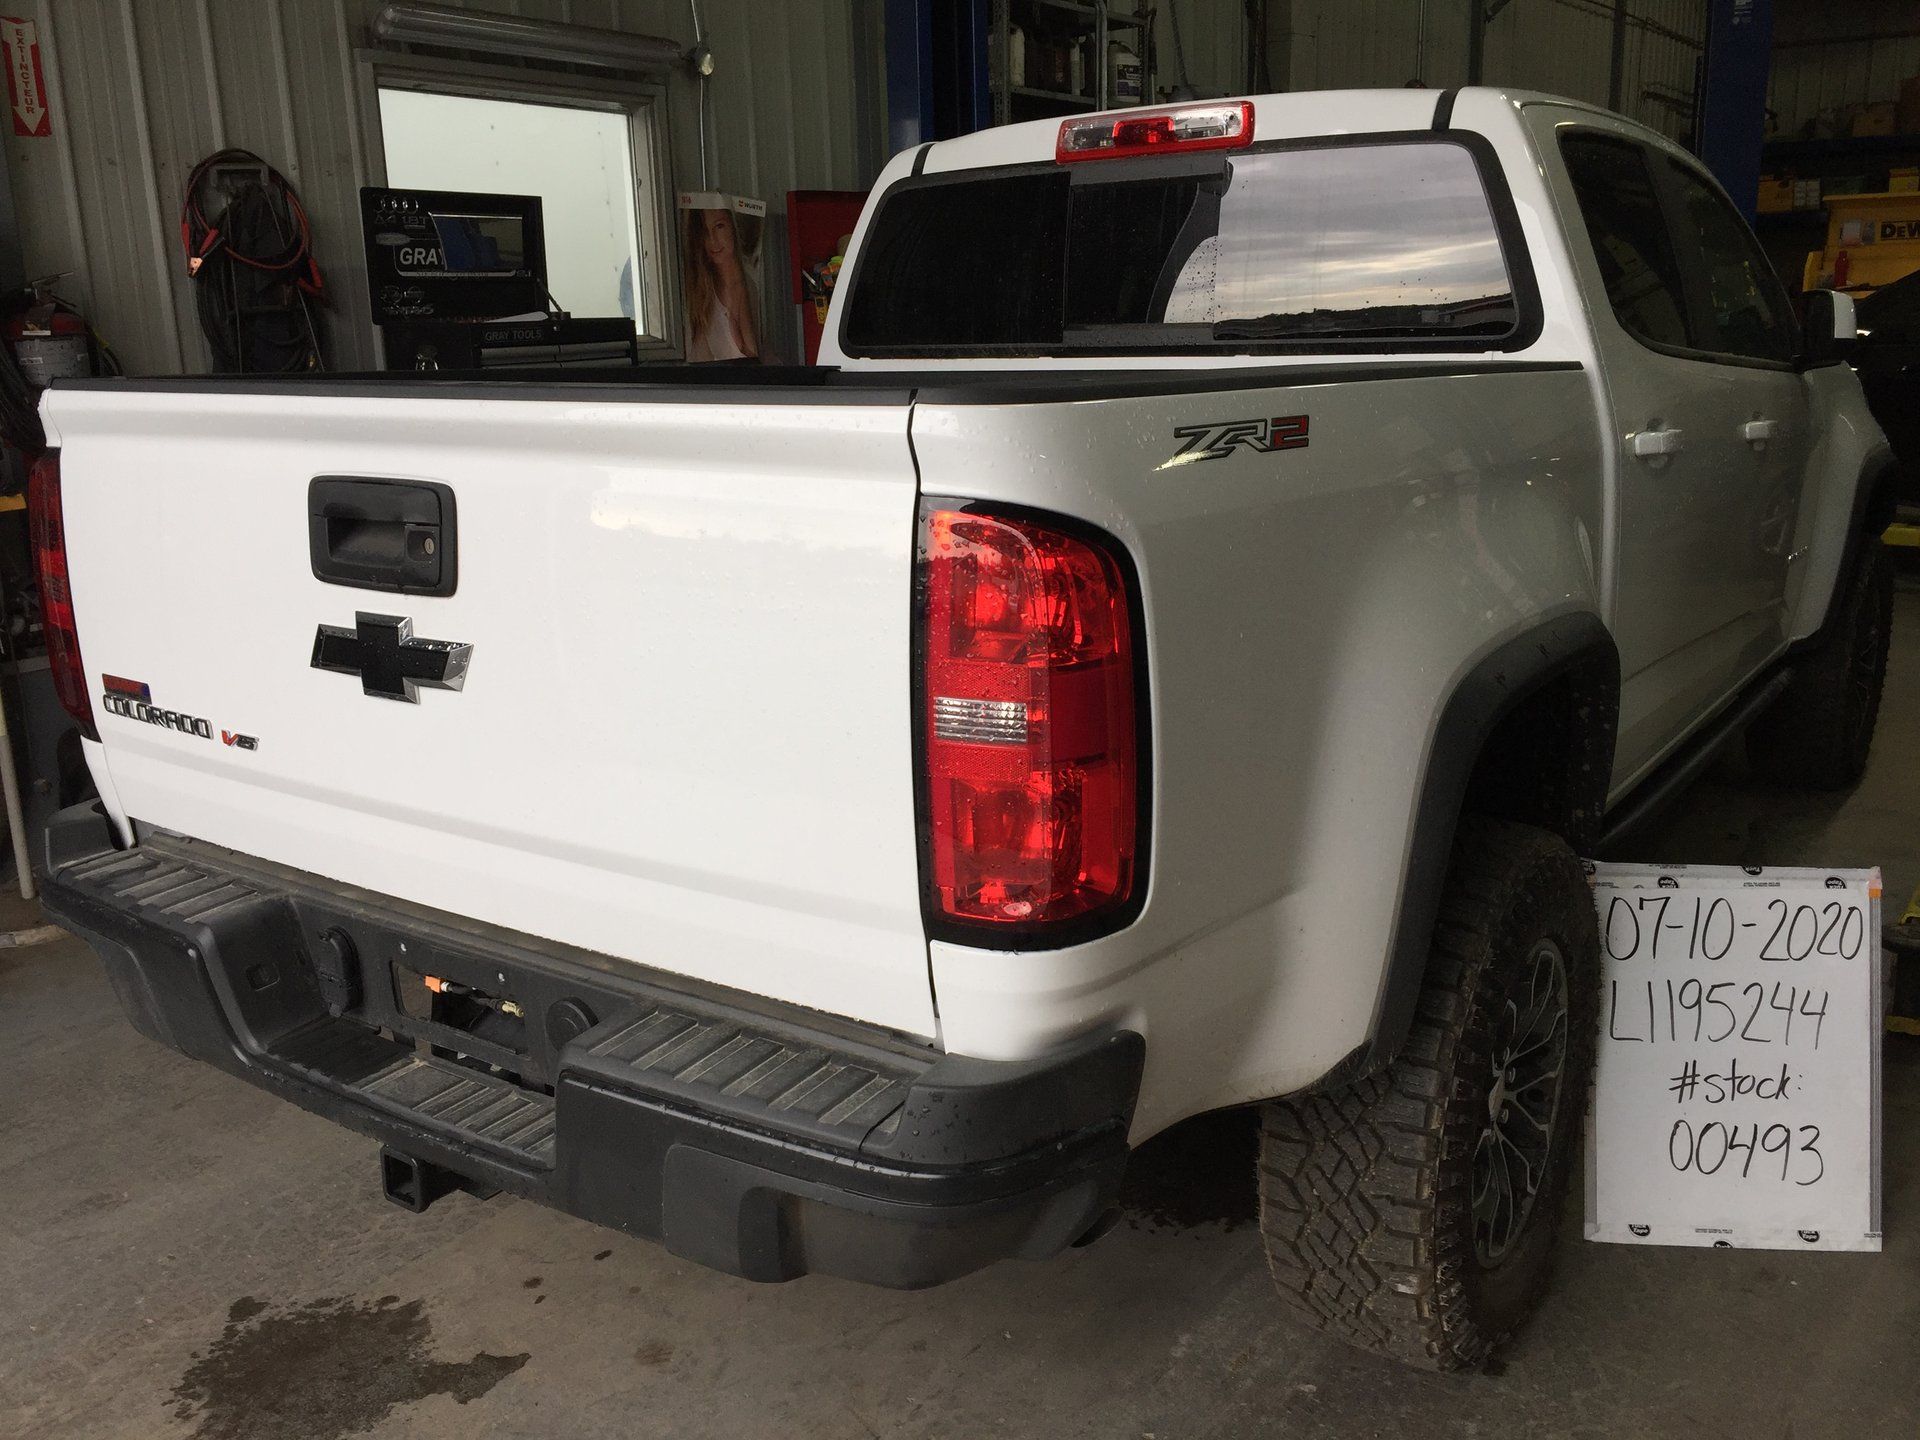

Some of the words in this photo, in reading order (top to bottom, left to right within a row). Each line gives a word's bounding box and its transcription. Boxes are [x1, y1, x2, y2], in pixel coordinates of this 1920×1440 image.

[15, 28, 34, 114] EXTINCTEUR
[485, 329, 510, 341] GRAY
[513, 328, 542, 340] TOOLS
[1152, 414, 1310, 472] ZR2
[103, 694, 214, 740] COLORADO
[221, 729, 260, 751] V6
[1605, 896, 1864, 960] 07-10-2020
[1609, 978, 1829, 1050] L1195244
[1669, 1058, 1802, 1103] #stock:
[1669, 1119, 1824, 1186] 00493
